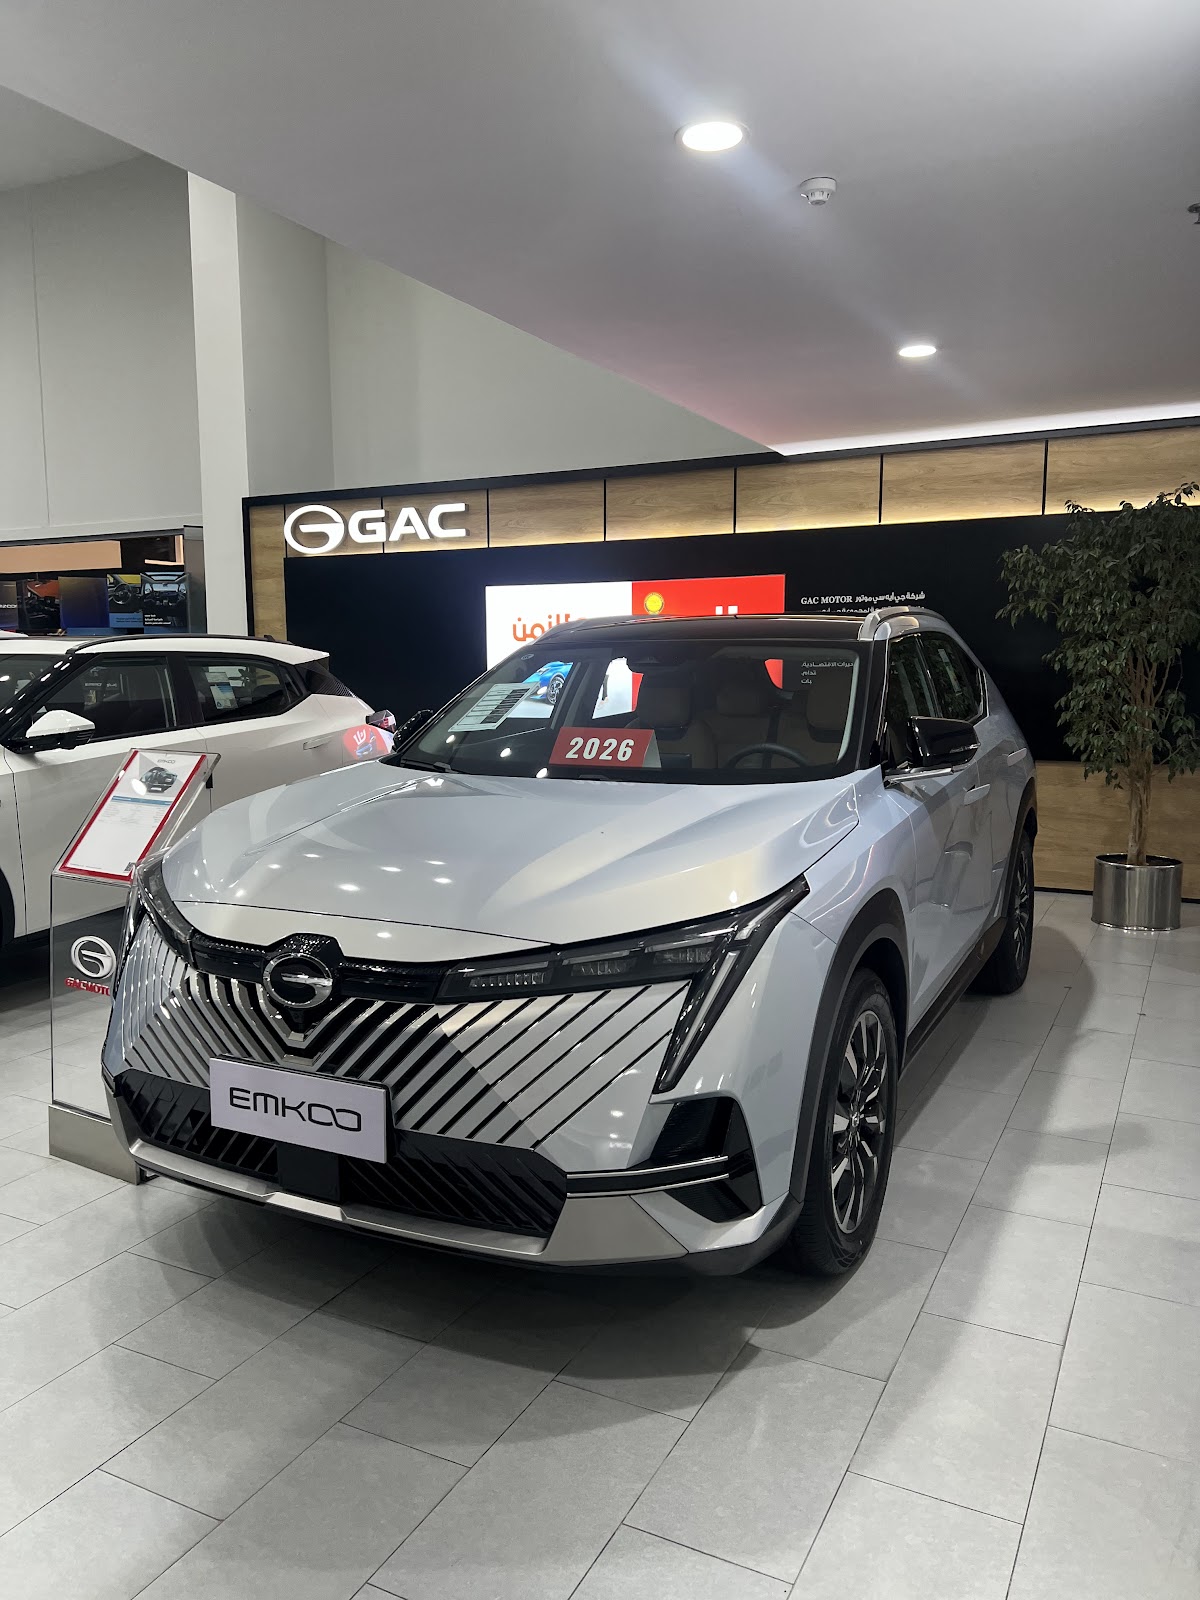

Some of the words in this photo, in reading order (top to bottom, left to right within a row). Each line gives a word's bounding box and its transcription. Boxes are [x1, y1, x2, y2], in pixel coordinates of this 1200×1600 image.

[348, 502, 467, 544] GAC
[800, 597, 819, 605] GAC
[820, 595, 853, 604] MOTOR
[565, 736, 635, 762] 2026
[229, 1086, 362, 1132] EMKOO
